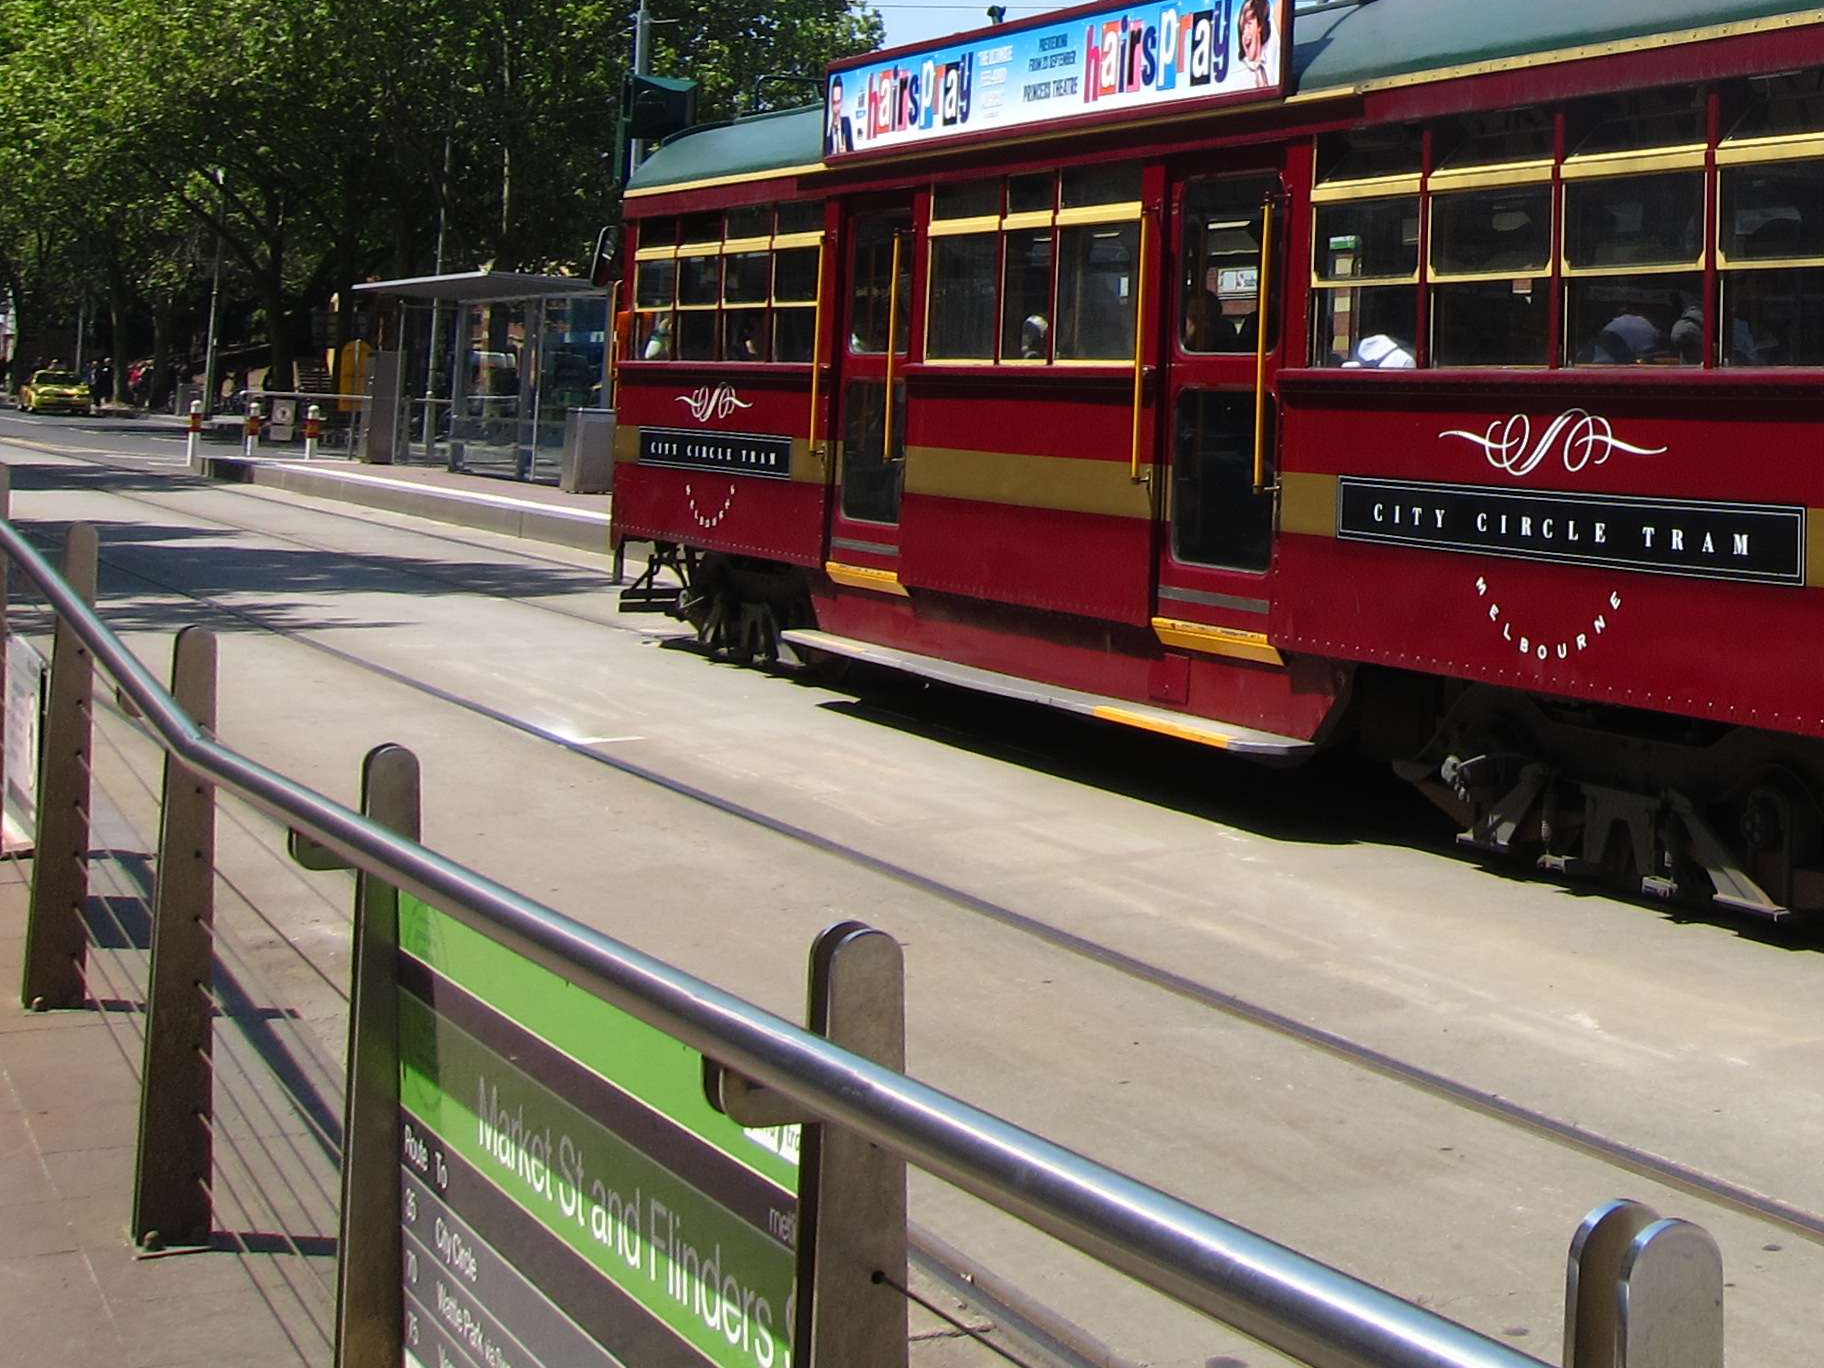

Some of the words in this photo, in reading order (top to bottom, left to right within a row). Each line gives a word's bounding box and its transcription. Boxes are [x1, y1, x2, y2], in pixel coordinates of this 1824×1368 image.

[866, 52, 974, 140] hairspray
[1023, 81, 1051, 102] PRINCESS
[1052, 76, 1079, 97] THEATRE
[650, 441, 678, 456] CITY
[687, 444, 732, 461] CIRCLE
[742, 449, 777, 466] TRAM
[1374, 503, 1447, 529] CITY
[1477, 512, 1608, 544] CIRCLE
[1643, 526, 1751, 557] TRAM
[1475, 575, 1622, 660] MELBOURNE
[404, 1124, 429, 1172] Route
[435, 1151, 448, 1189] To
[405, 1187, 417, 1222] 35
[435, 1216, 452, 1265] City
[451, 1233, 478, 1282] Circle
[478, 1076, 553, 1203] Market
[556, 1134, 586, 1228] St
[590, 1176, 642, 1271] and
[650, 1196, 775, 1368] Flinders
[406, 1249, 418, 1284] 70
[408, 1311, 419, 1345] 75
